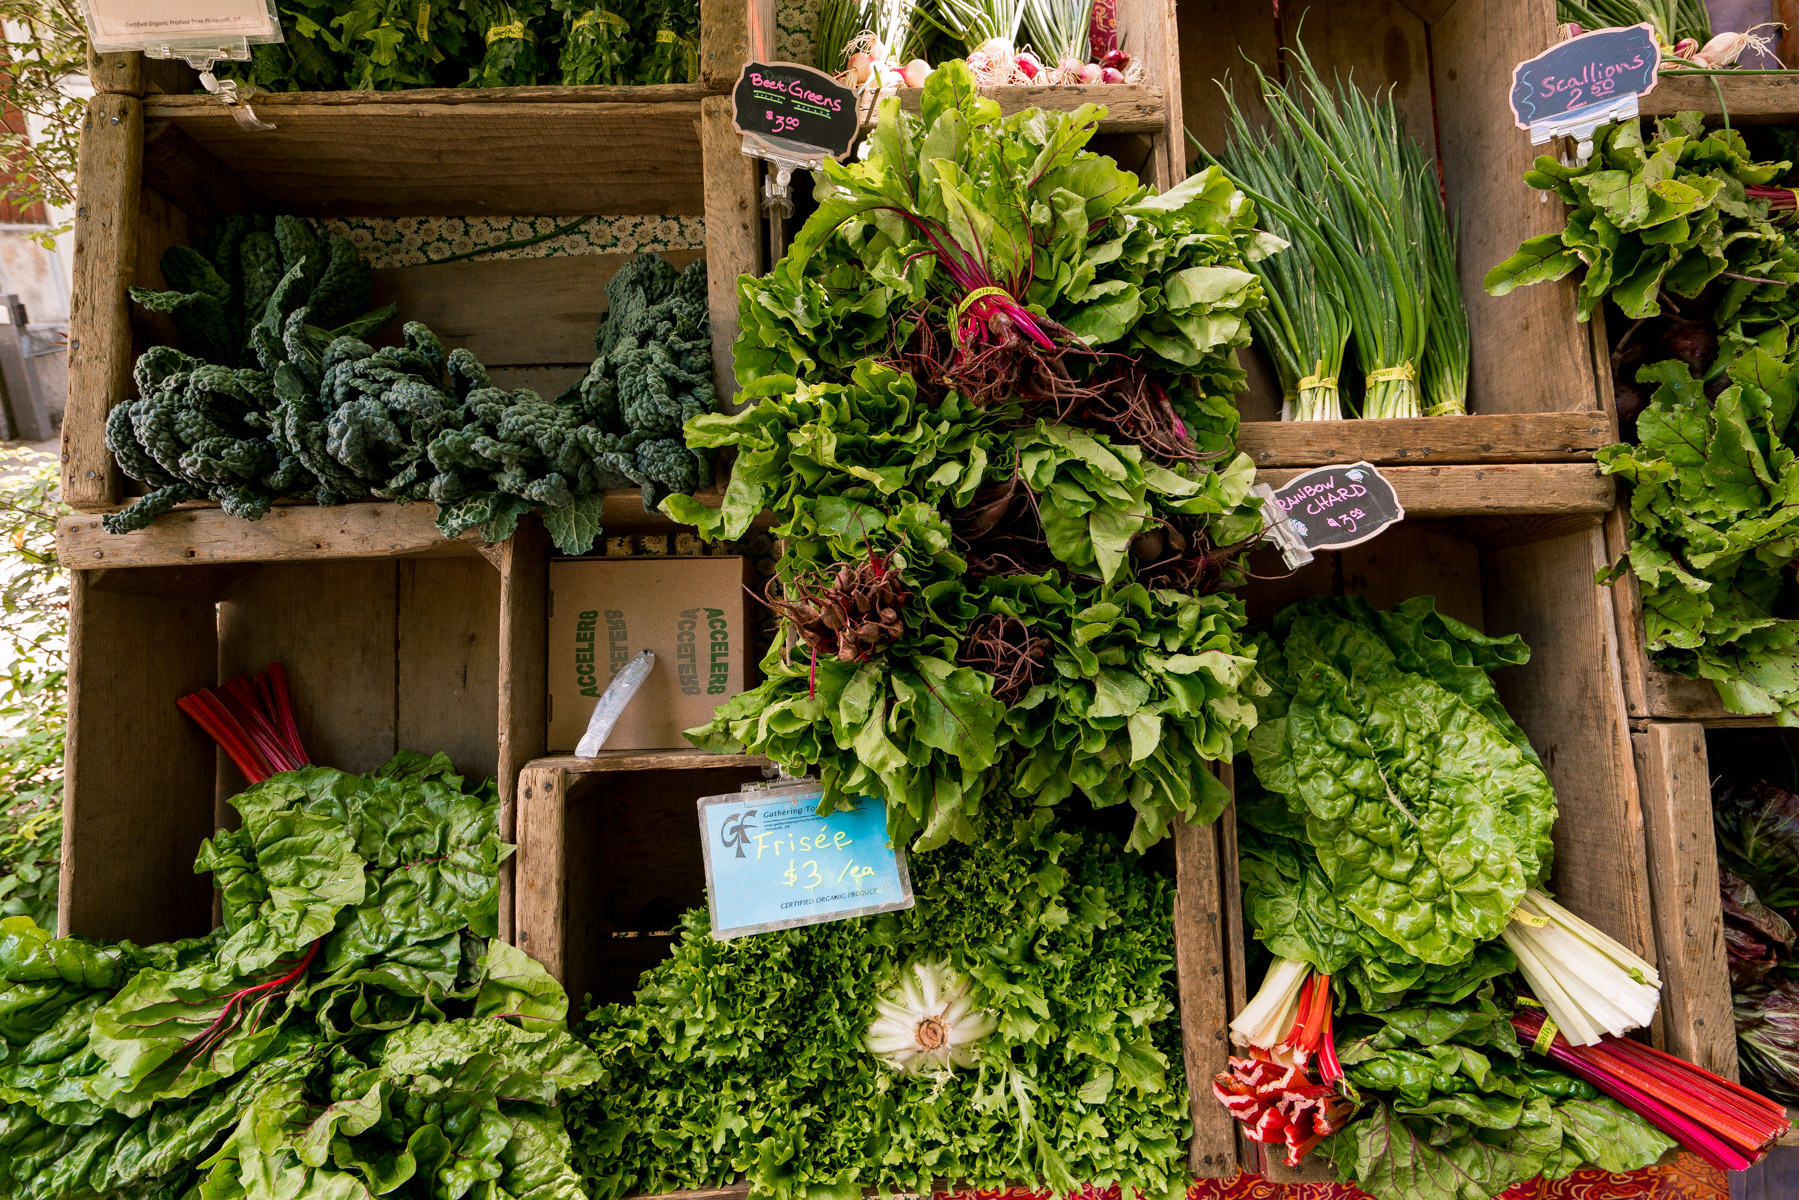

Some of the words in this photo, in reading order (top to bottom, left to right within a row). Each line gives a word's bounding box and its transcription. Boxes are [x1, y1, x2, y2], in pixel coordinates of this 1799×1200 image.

[749, 73, 786, 92] Beet
[788, 80, 841, 112] Greens
[1540, 54, 1644, 98] Scallions
[1275, 475, 1335, 513] RAINBOW
[1306, 484, 1367, 515] CHARD
[575, 609, 601, 698] ACCELER8
[702, 607, 729, 695] ACCELER8
[763, 806, 803, 819] Gathering
[752, 825, 853, 860] Frisée
[782, 859, 822, 890] $3
[780, 898, 815, 909] CERTIFIED
[815, 893, 847, 903] ORGANIC
[847, 887, 878, 898] PRODUCE
